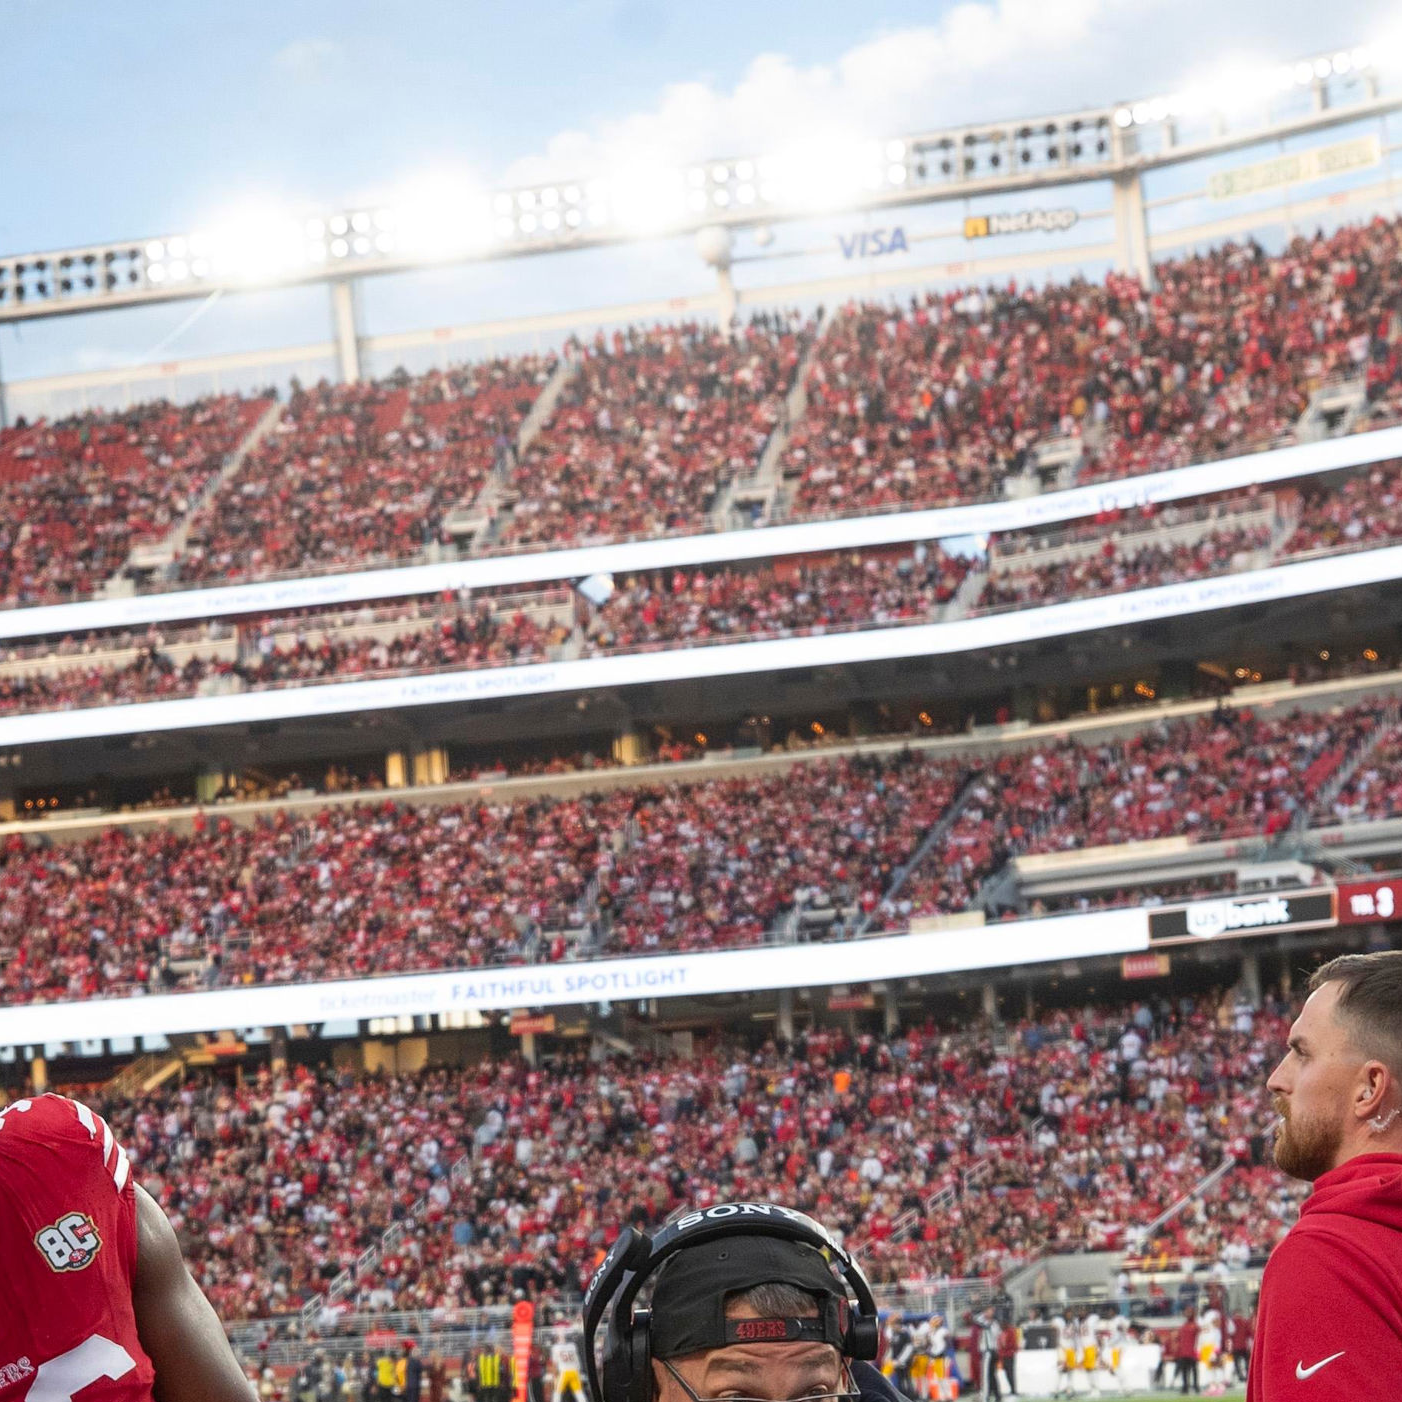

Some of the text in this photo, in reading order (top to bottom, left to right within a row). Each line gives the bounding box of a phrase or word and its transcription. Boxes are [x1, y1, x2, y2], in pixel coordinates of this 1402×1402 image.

[993, 207, 1078, 234] NetApp
[838, 226, 908, 260] VISA
[1226, 896, 1291, 930] bank
[1376, 886, 1394, 918] 3
[452, 978, 556, 1000] FAITHFUL
[564, 967, 688, 993] SPOTLIGHT
[677, 1203, 801, 1232] SONY
[735, 1320, 787, 1340] 49ERS
